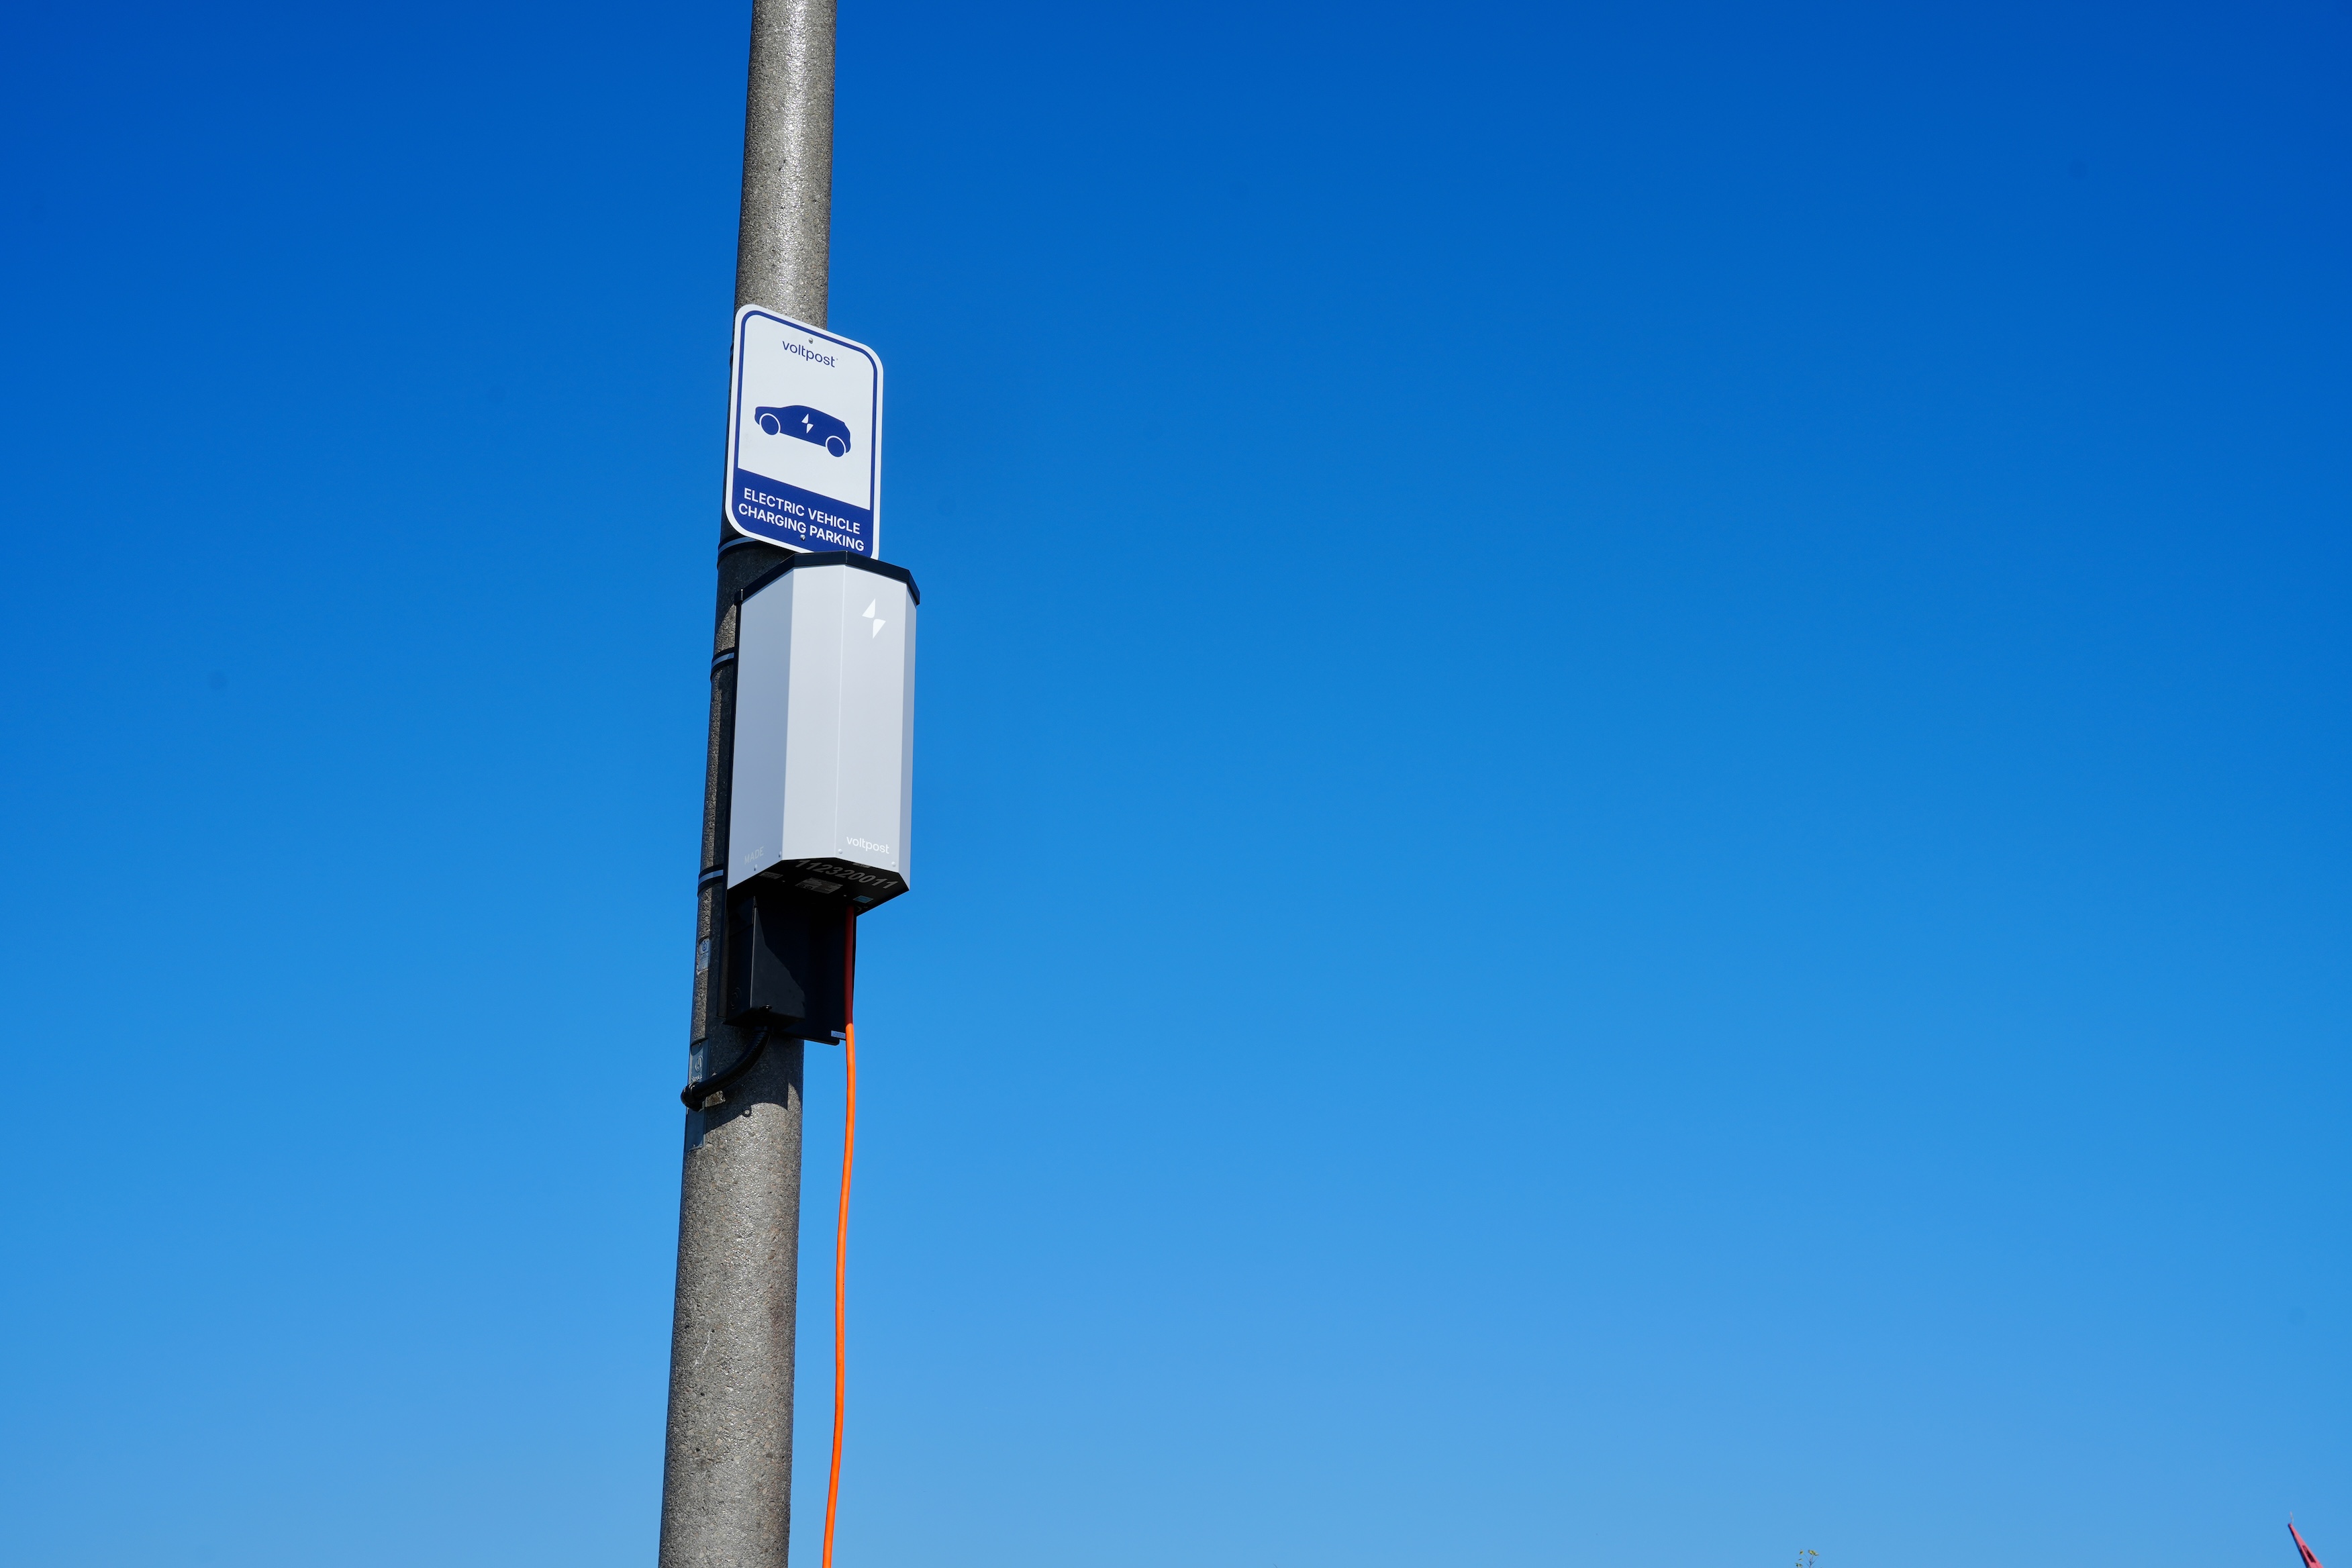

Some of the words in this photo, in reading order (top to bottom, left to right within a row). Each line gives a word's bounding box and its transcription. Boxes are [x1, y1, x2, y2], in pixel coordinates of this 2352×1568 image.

[782, 340, 836, 368] voltpost
[744, 487, 805, 517] ELECTRIC
[807, 507, 861, 535] VEHICLE
[738, 503, 807, 534] CHARGING
[809, 524, 865, 552] PARKING
[744, 846, 765, 865] MADE
[846, 836, 889, 854] voltpost
[795, 859, 899, 889] 112320011
